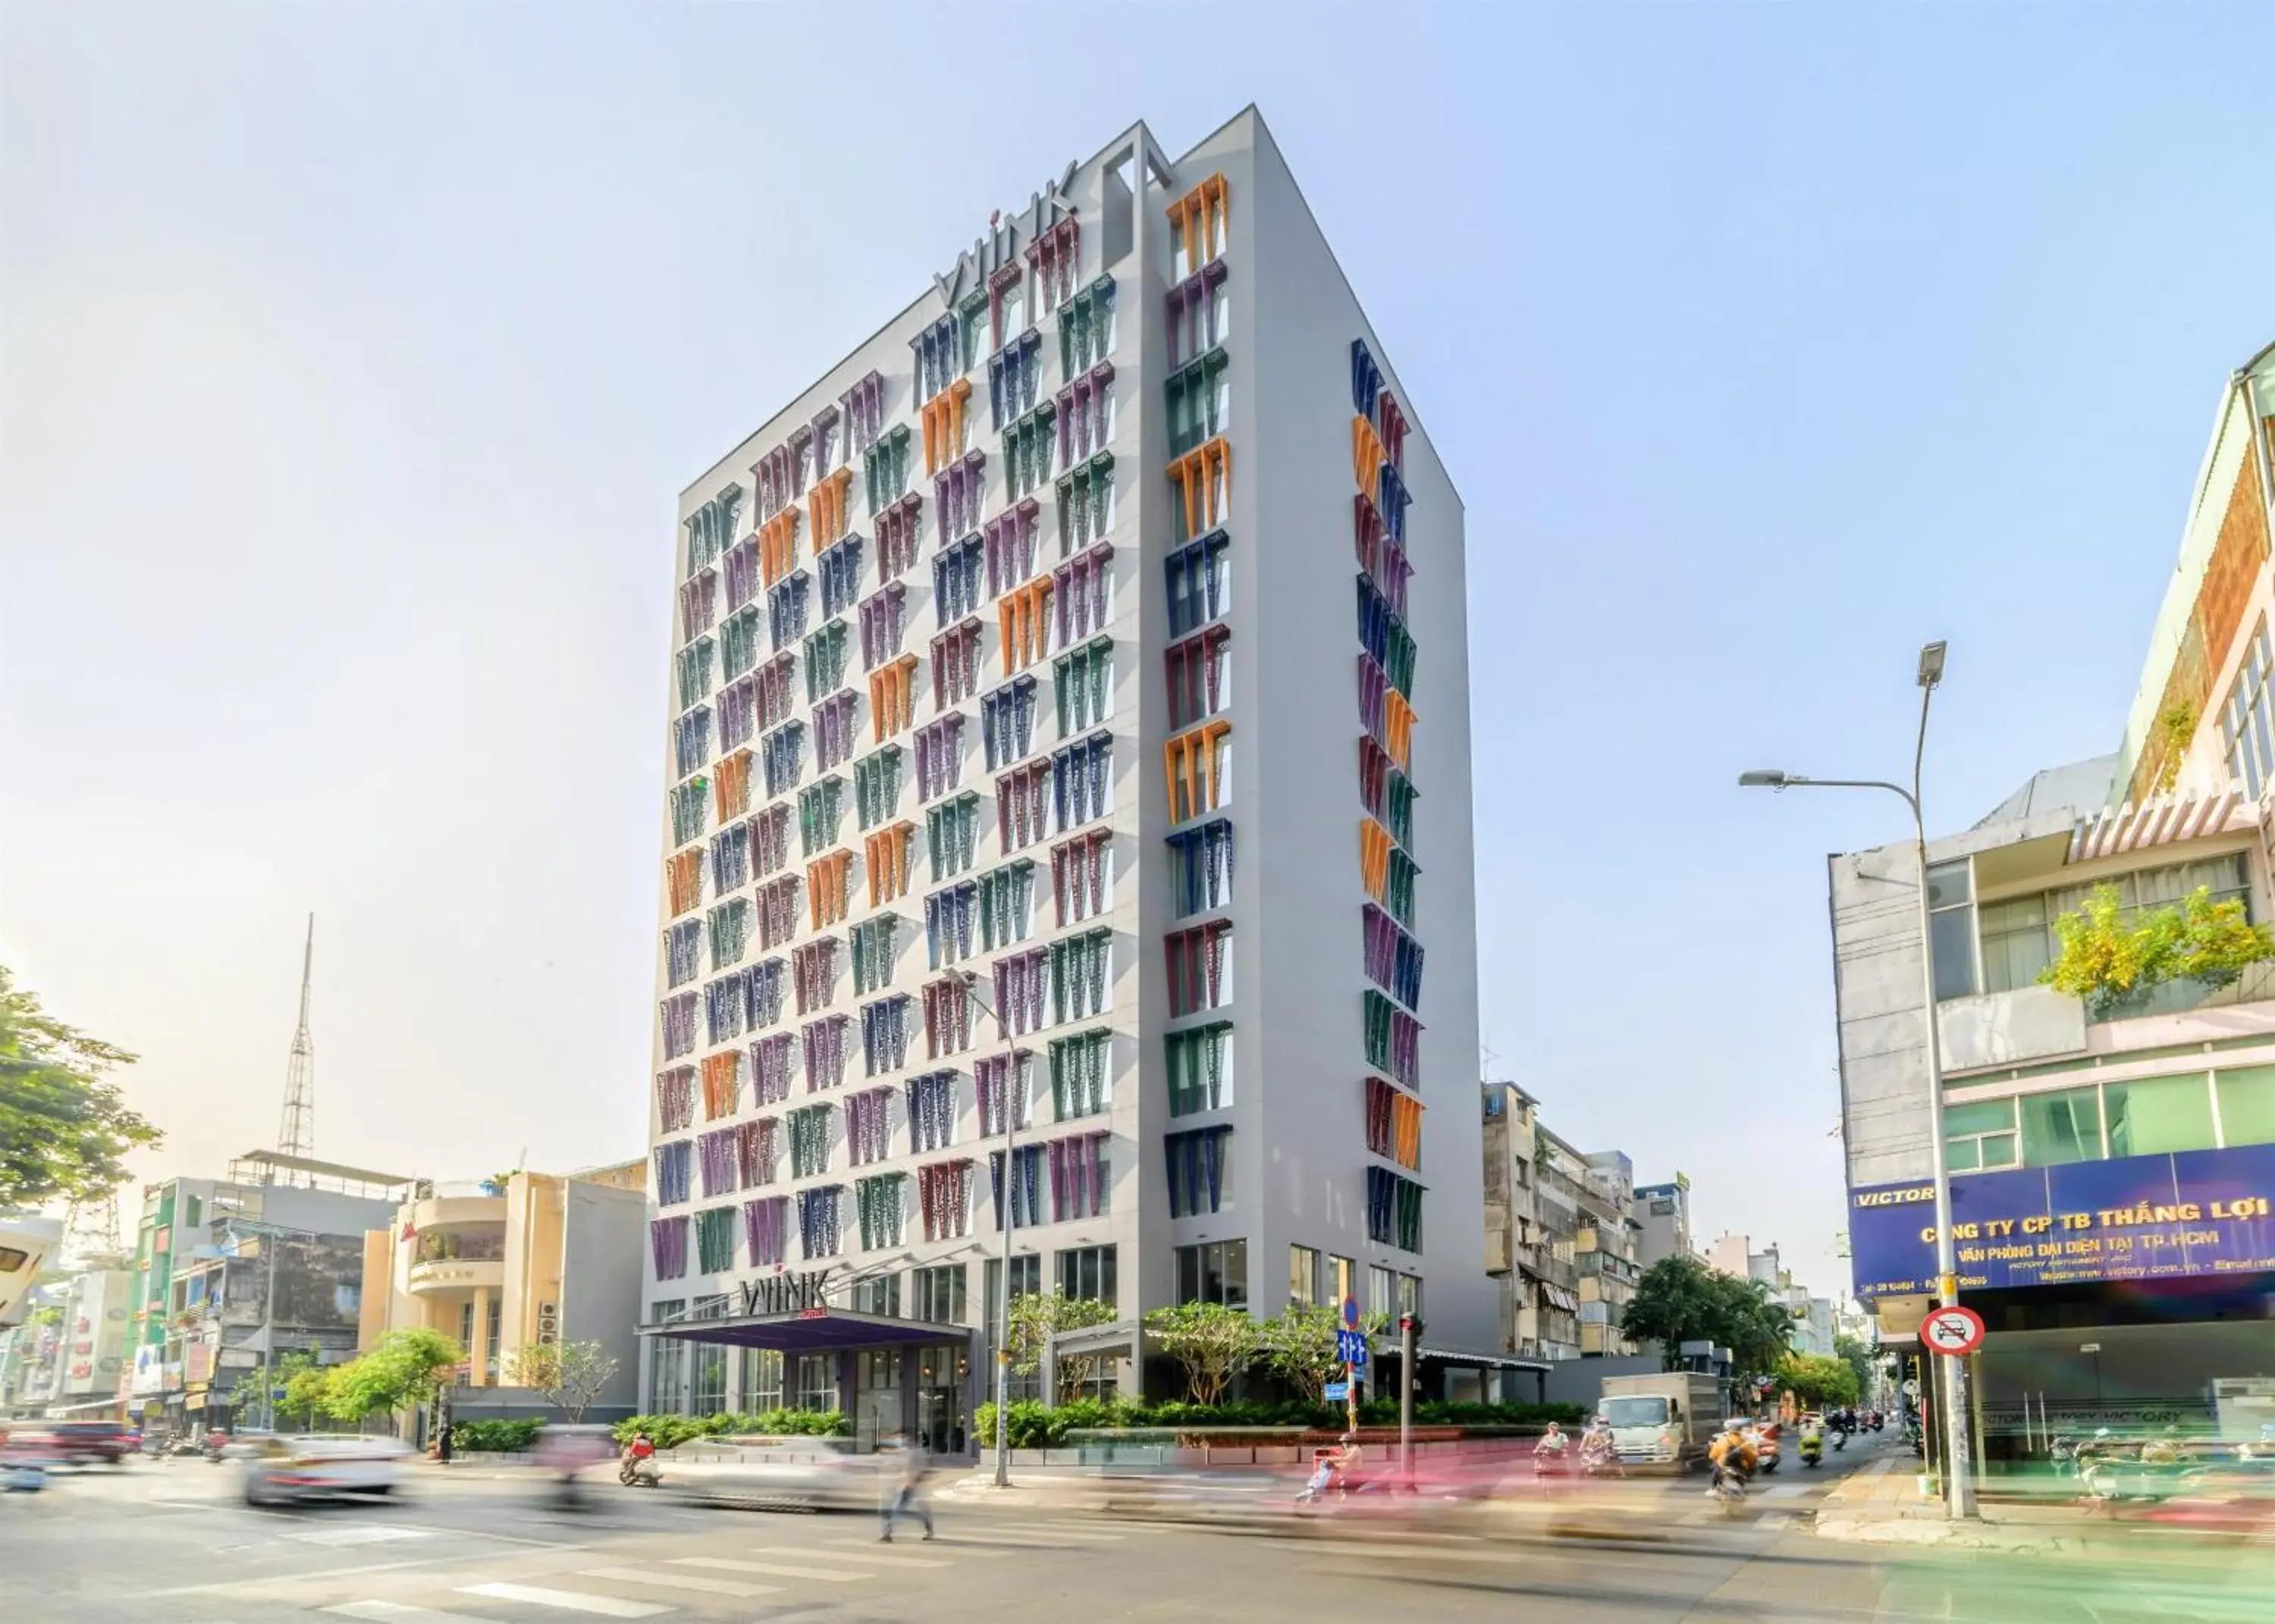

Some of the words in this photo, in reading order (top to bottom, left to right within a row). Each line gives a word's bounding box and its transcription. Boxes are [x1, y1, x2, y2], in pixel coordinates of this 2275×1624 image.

[1921, 1223, 1978, 1243] CNG
[1985, 1219, 2014, 1237] TY
[2022, 1215, 2053, 1234] CP
[2060, 1213, 2091, 1230] TB
[2098, 1200, 2201, 1226] THẮNG
[2210, 1196, 2269, 1220] LỢI
